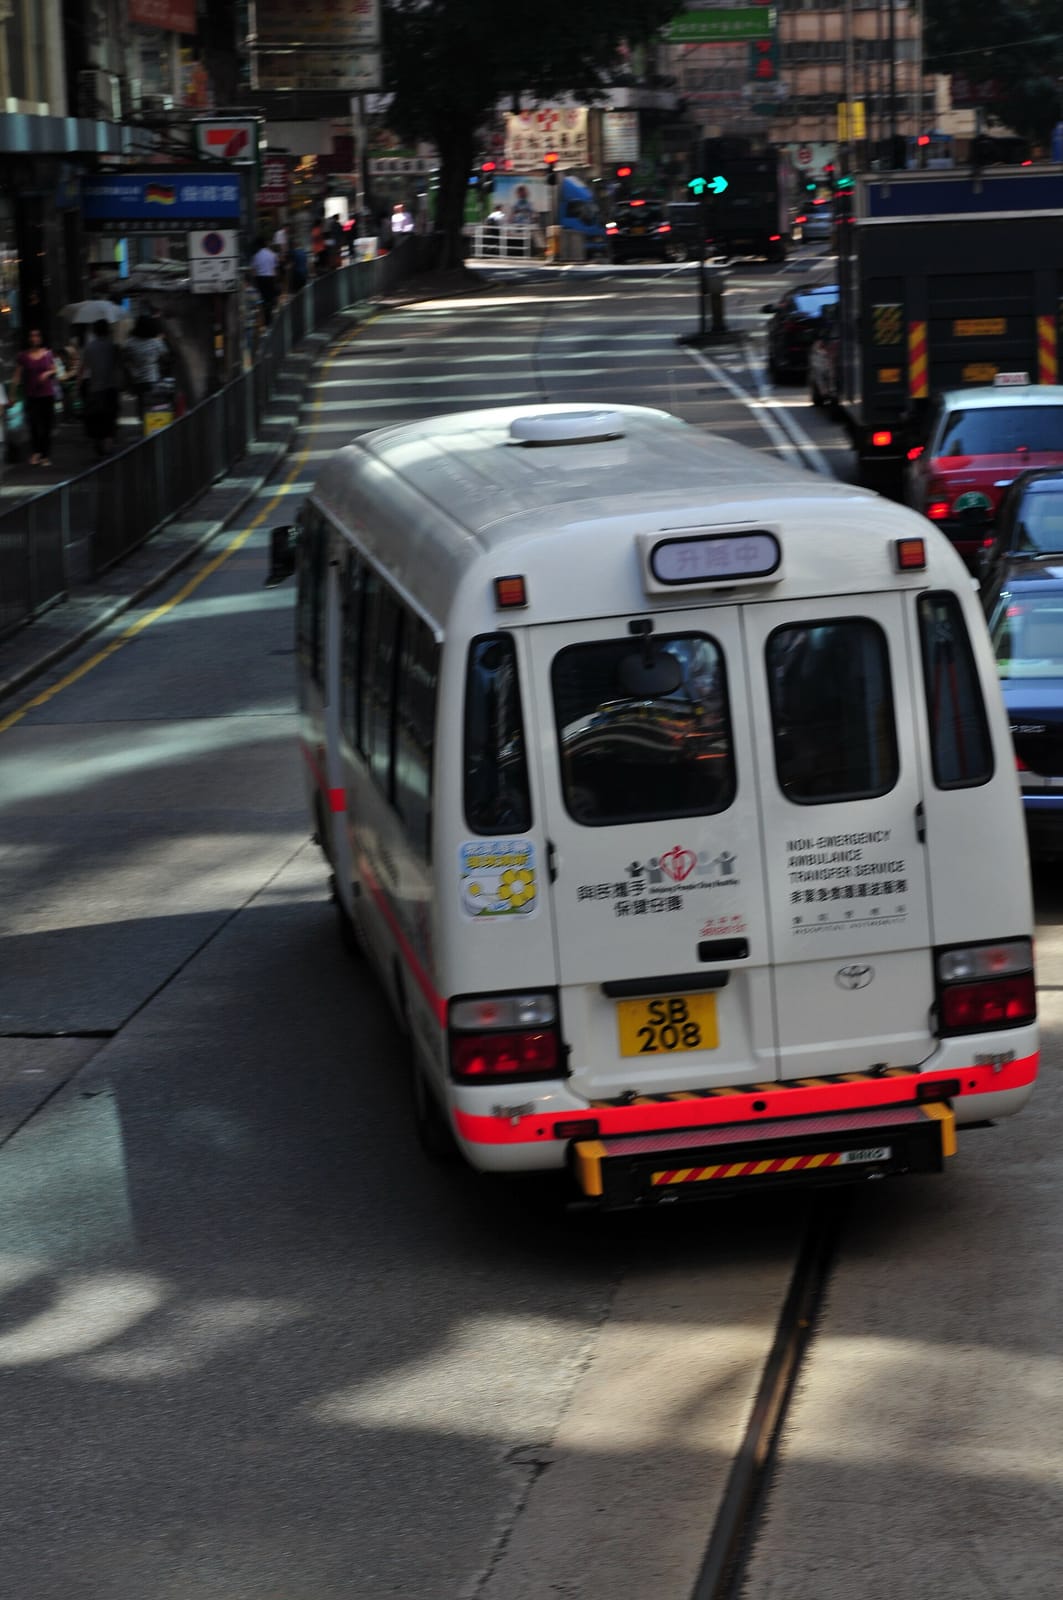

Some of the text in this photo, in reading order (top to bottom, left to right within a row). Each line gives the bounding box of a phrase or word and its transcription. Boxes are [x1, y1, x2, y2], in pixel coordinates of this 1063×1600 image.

[786, 829, 892, 851] NON-EMERGENCY
[787, 848, 863, 868] AMBULANCE
[788, 860, 906, 883] TRANSFER SERVICE
[647, 998, 689, 1026] SB
[636, 1022, 702, 1053] 208
